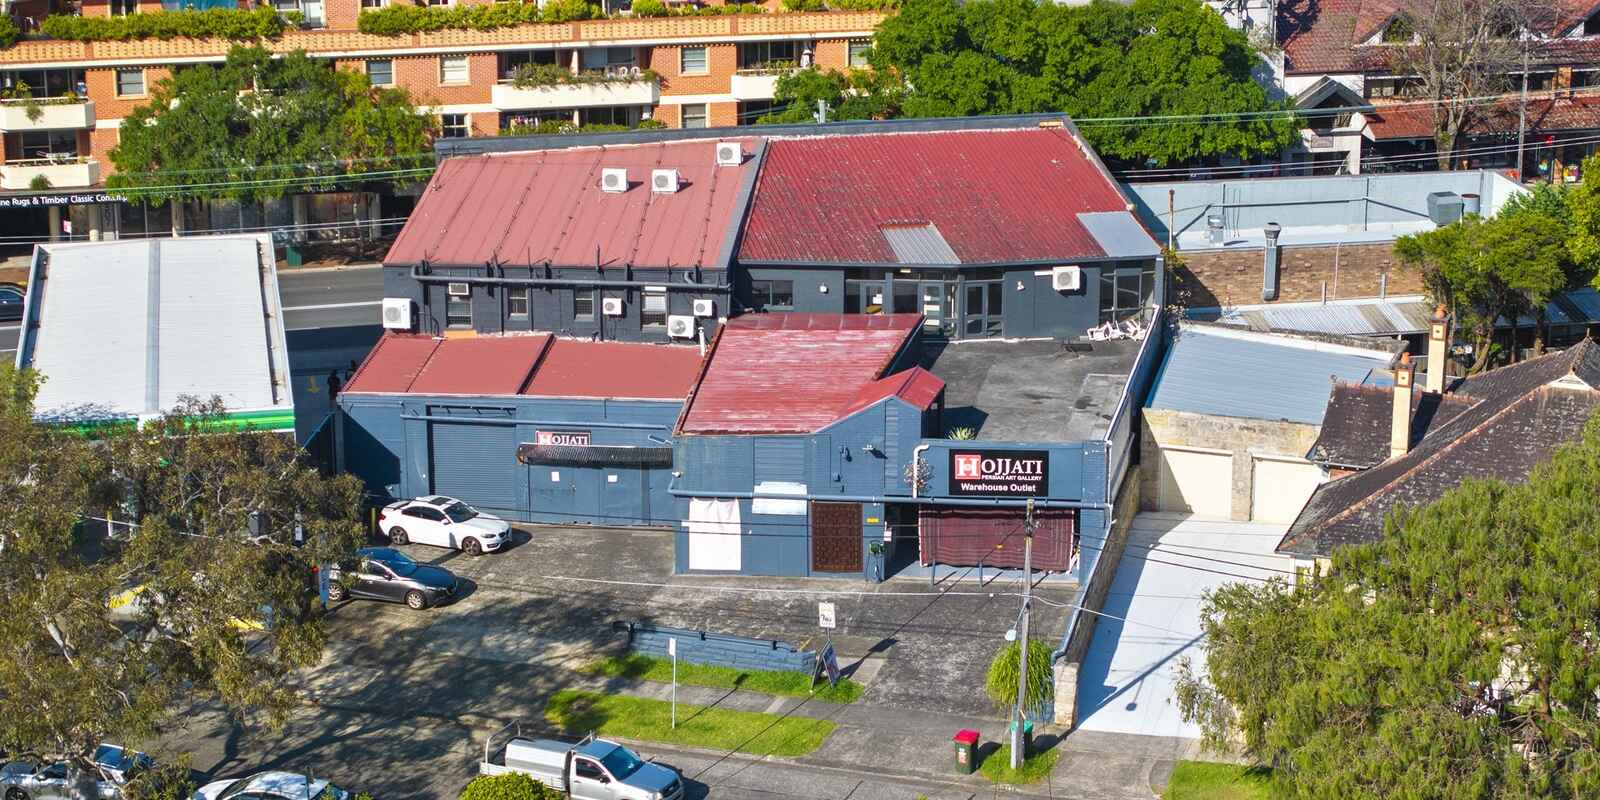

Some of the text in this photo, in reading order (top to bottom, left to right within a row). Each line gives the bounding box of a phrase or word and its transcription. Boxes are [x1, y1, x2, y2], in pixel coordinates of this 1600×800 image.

[12, 198, 30, 206] Rugs
[41, 196, 68, 204] Timber
[71, 195, 94, 203] Classic
[538, 434, 588, 445] HOJJATI
[957, 457, 1042, 476] HOJJATI
[961, 483, 1036, 492] Warehouse Outlet
